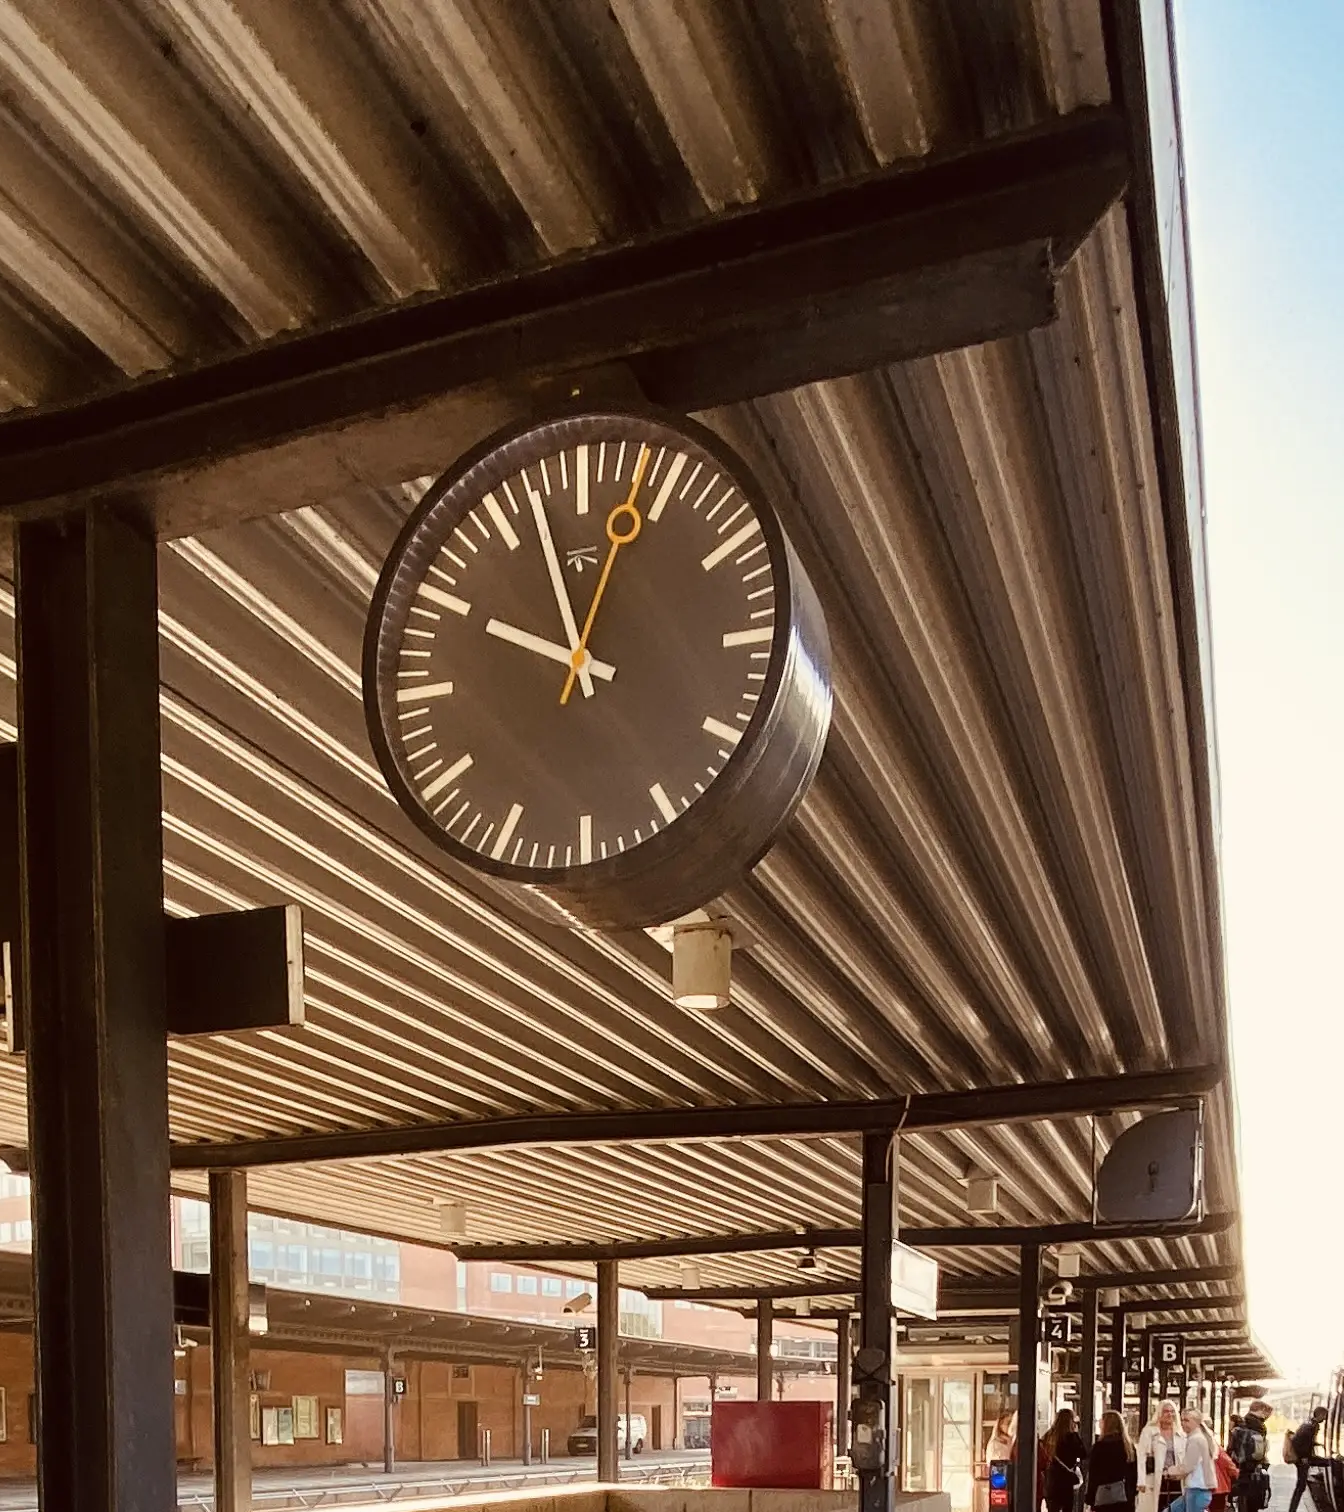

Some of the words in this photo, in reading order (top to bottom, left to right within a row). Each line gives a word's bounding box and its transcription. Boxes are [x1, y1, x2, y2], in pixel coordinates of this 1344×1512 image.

[1051, 1324, 1062, 1339] 4
[579, 1333, 589, 1347] 3
[1162, 1343, 1177, 1362] B
